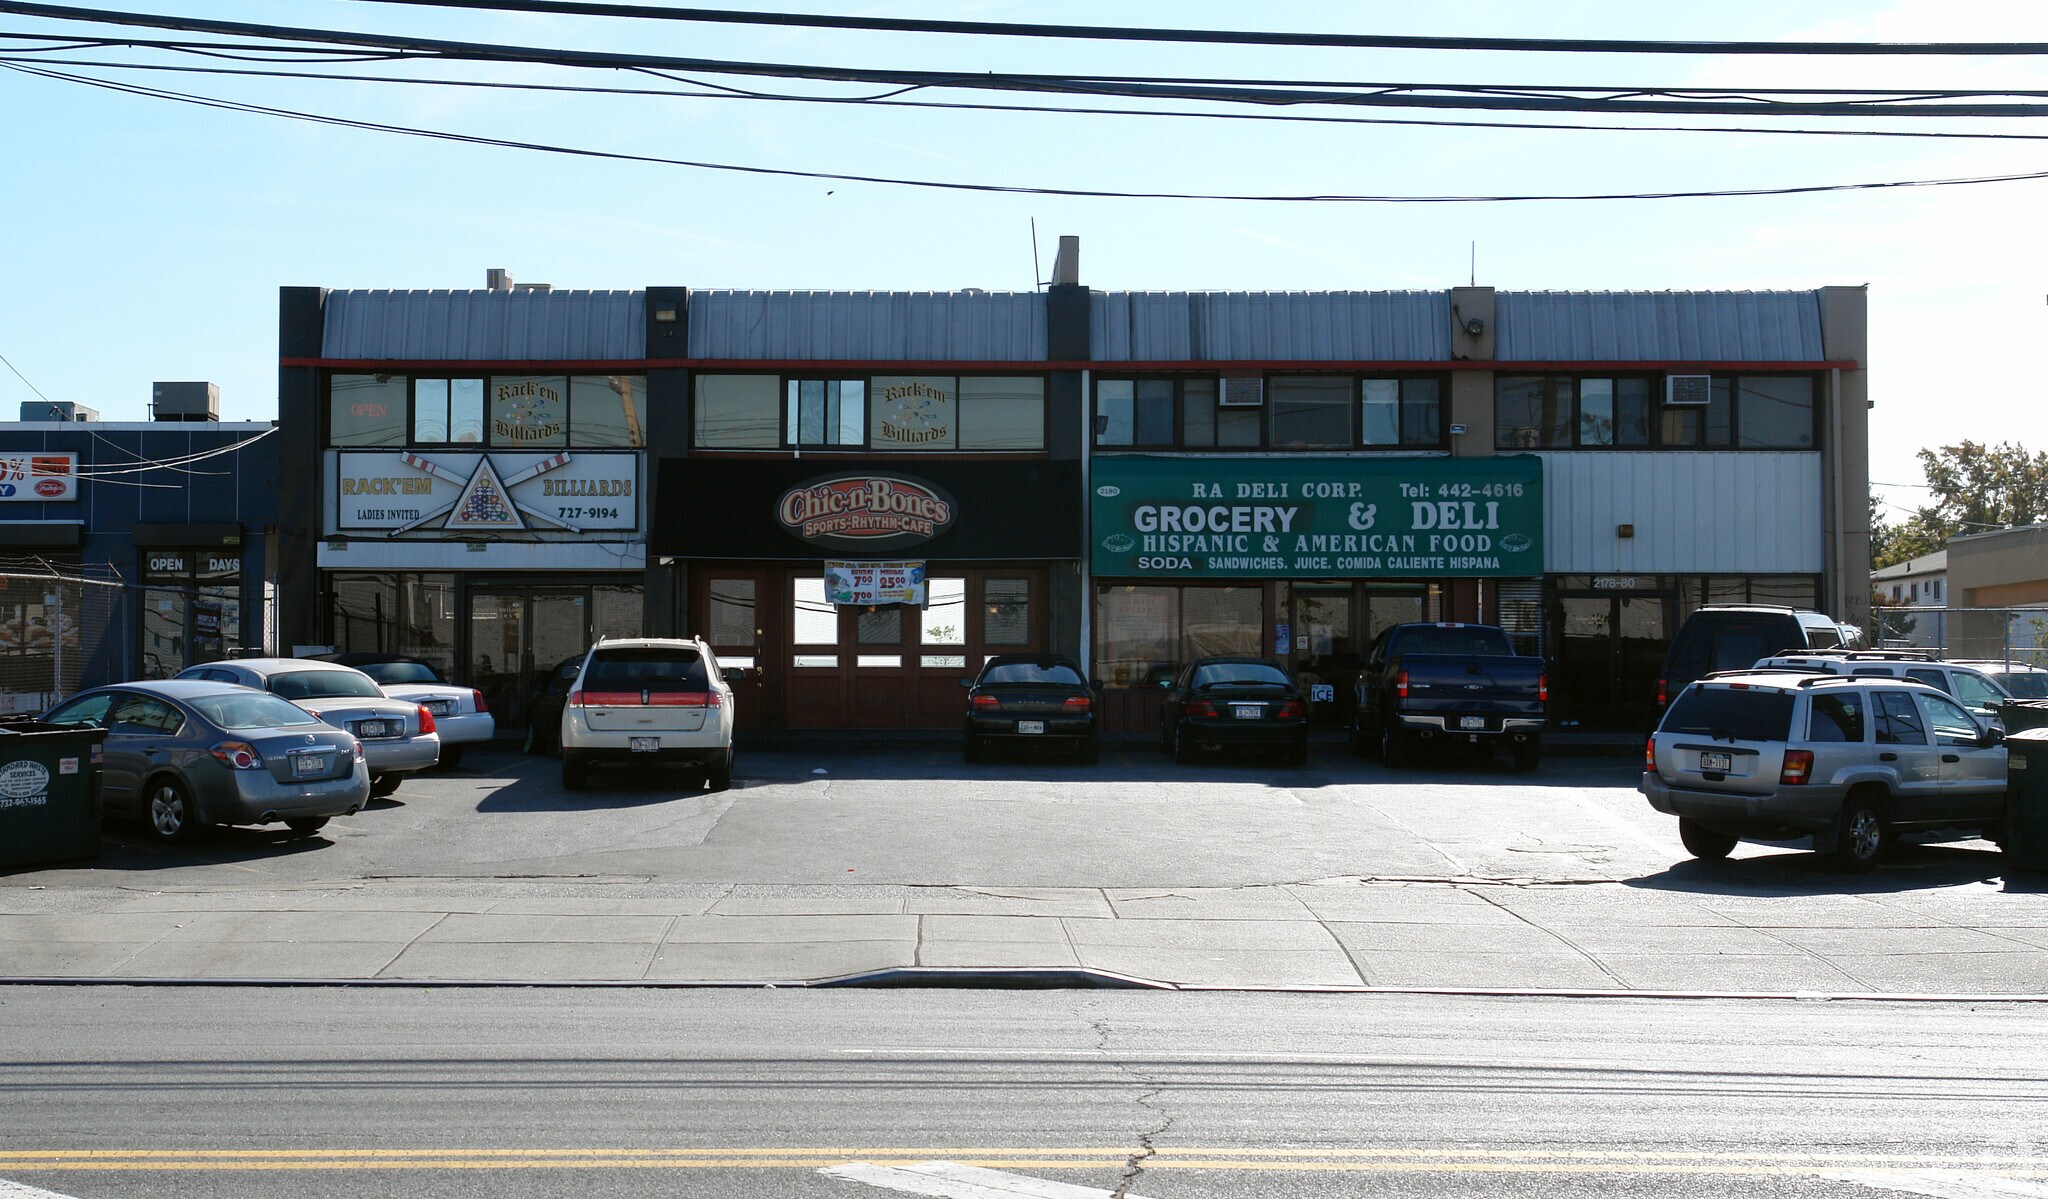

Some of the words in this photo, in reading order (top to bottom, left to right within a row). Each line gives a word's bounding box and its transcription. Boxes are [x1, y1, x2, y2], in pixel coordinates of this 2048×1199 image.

[498, 381, 559, 403] Rack'em
[885, 382, 946, 404] Rack'em
[351, 403, 388, 417] OPEN
[495, 419, 561, 441] Billiards
[882, 421, 948, 443] Billiards
[342, 478, 432, 496] RACK'EM
[543, 479, 632, 497] BILLIARDS
[1099, 488, 1118, 496] 2180
[1192, 483, 1224, 498] RA
[1236, 483, 1289, 498] DELI
[1301, 482, 1363, 498] CORP.
[1399, 483, 1430, 498] Tel:
[1438, 483, 1524, 498] 442-4616
[357, 509, 385, 520] LADIES
[387, 509, 420, 520] INVITED
[558, 507, 618, 519] 727-9194
[1134, 505, 1298, 533] GROCERY
[1348, 501, 1377, 531] &
[1411, 501, 1499, 530] DELI
[1142, 535, 1249, 553] HISPANIC
[1262, 535, 1279, 553] &
[1294, 534, 1416, 553] AMERICAN
[1429, 534, 1492, 553] FOOD
[150, 558, 183, 571] OPEN
[209, 558, 240, 571] DAYS
[1137, 556, 1193, 570] SODA
[1336, 556, 1382, 570] COMIDA
[1387, 556, 1444, 570] CALIENTE
[1449, 556, 1500, 570] HISPANA
[1593, 578, 1635, 588] 2178-80
[1312, 690, 1332, 701] ICE
[10, 770, 36, 779] SERVICES
[29, 761, 47, 775] WASTE
